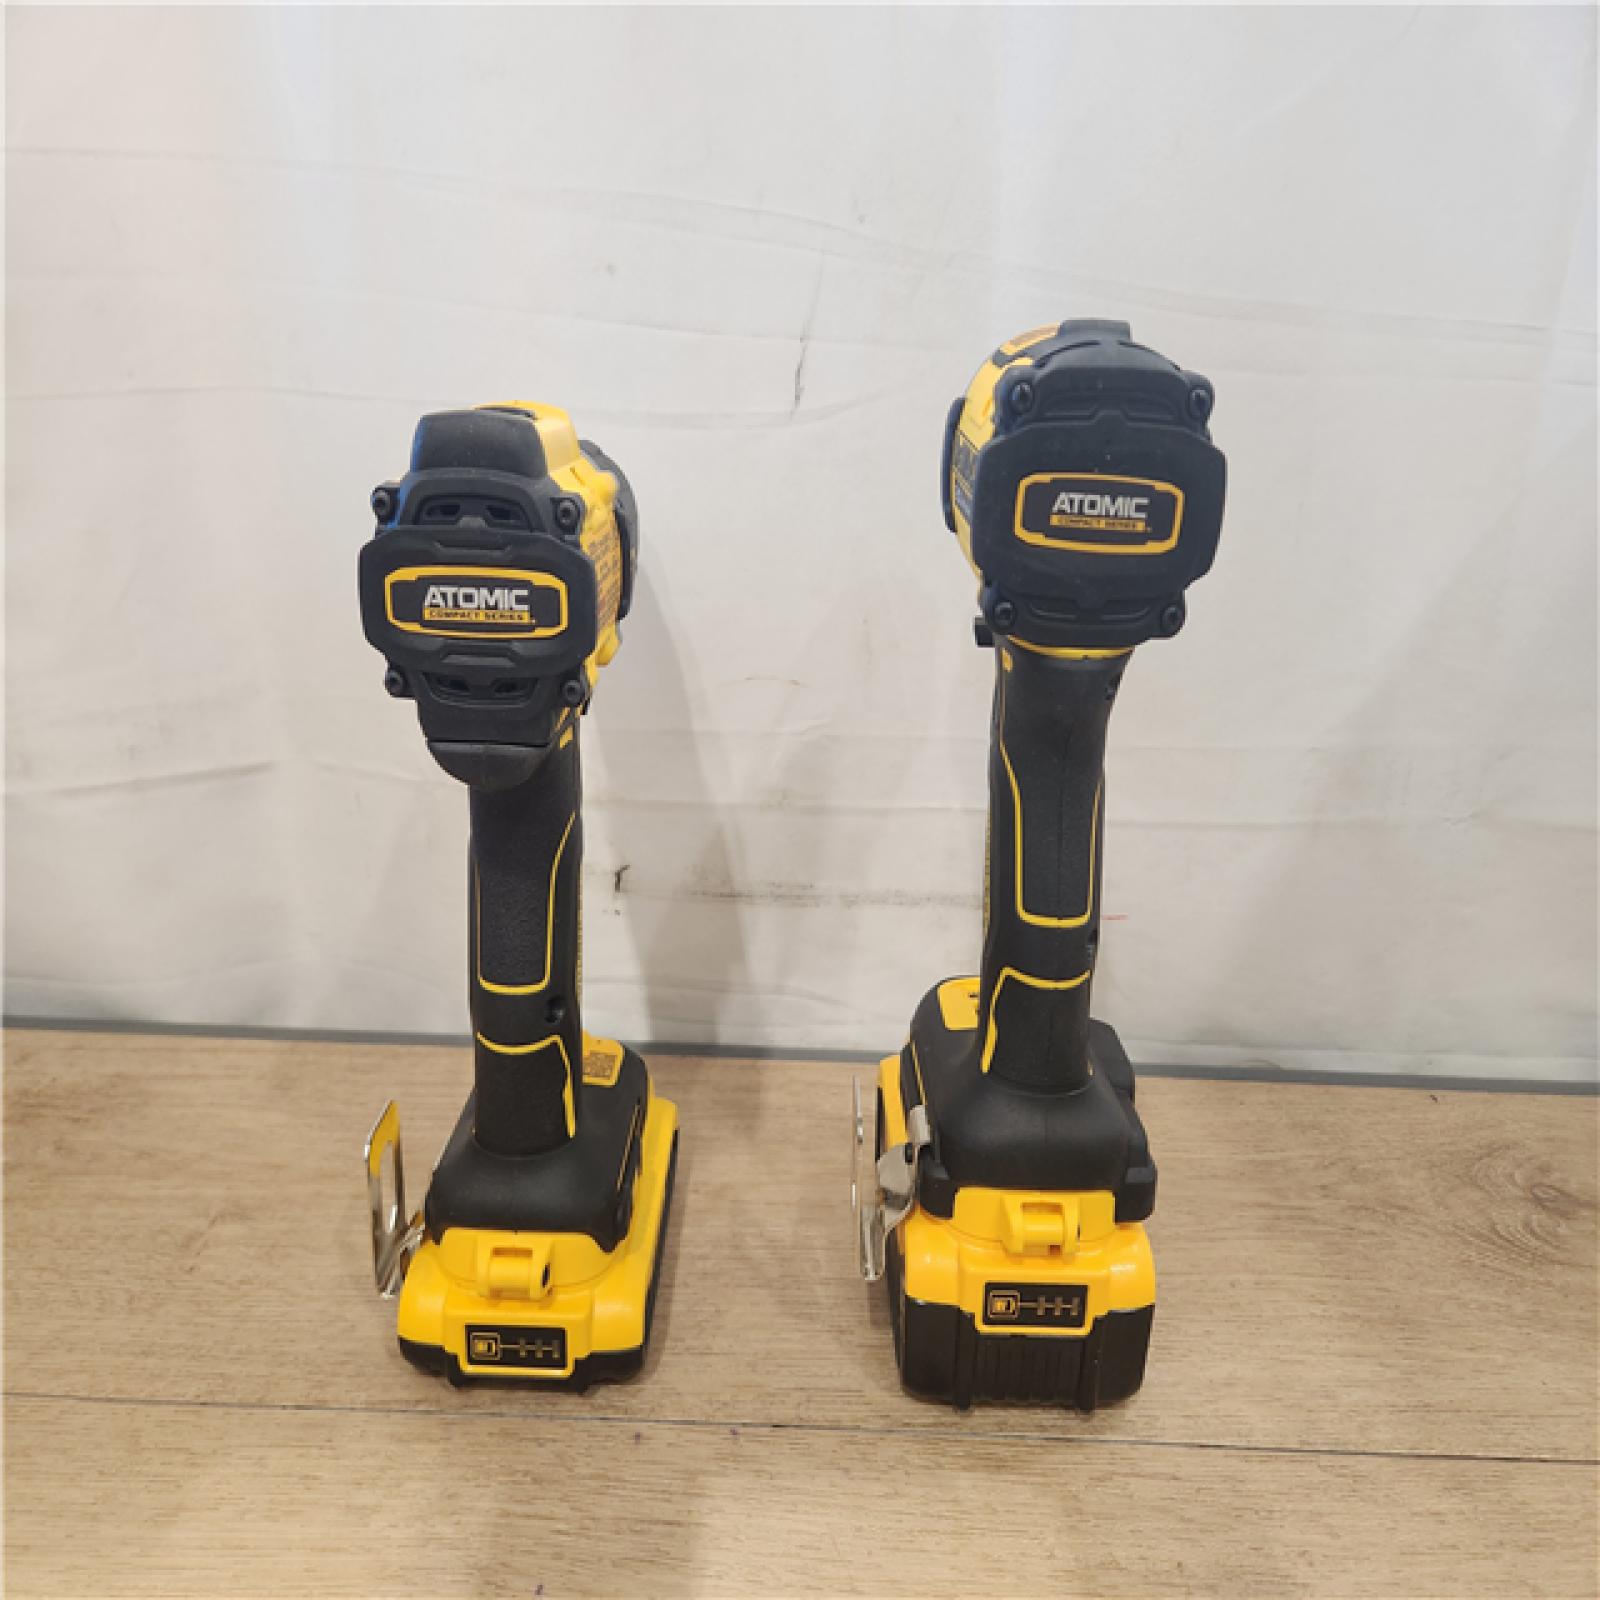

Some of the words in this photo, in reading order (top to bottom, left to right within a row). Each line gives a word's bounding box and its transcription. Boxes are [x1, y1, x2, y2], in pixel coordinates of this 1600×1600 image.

[1052, 492, 1149, 518] ATOMIC
[424, 585, 529, 610] ATOMIC
[429, 609, 480, 620] COMPACT
[484, 611, 524, 622] SERIES
